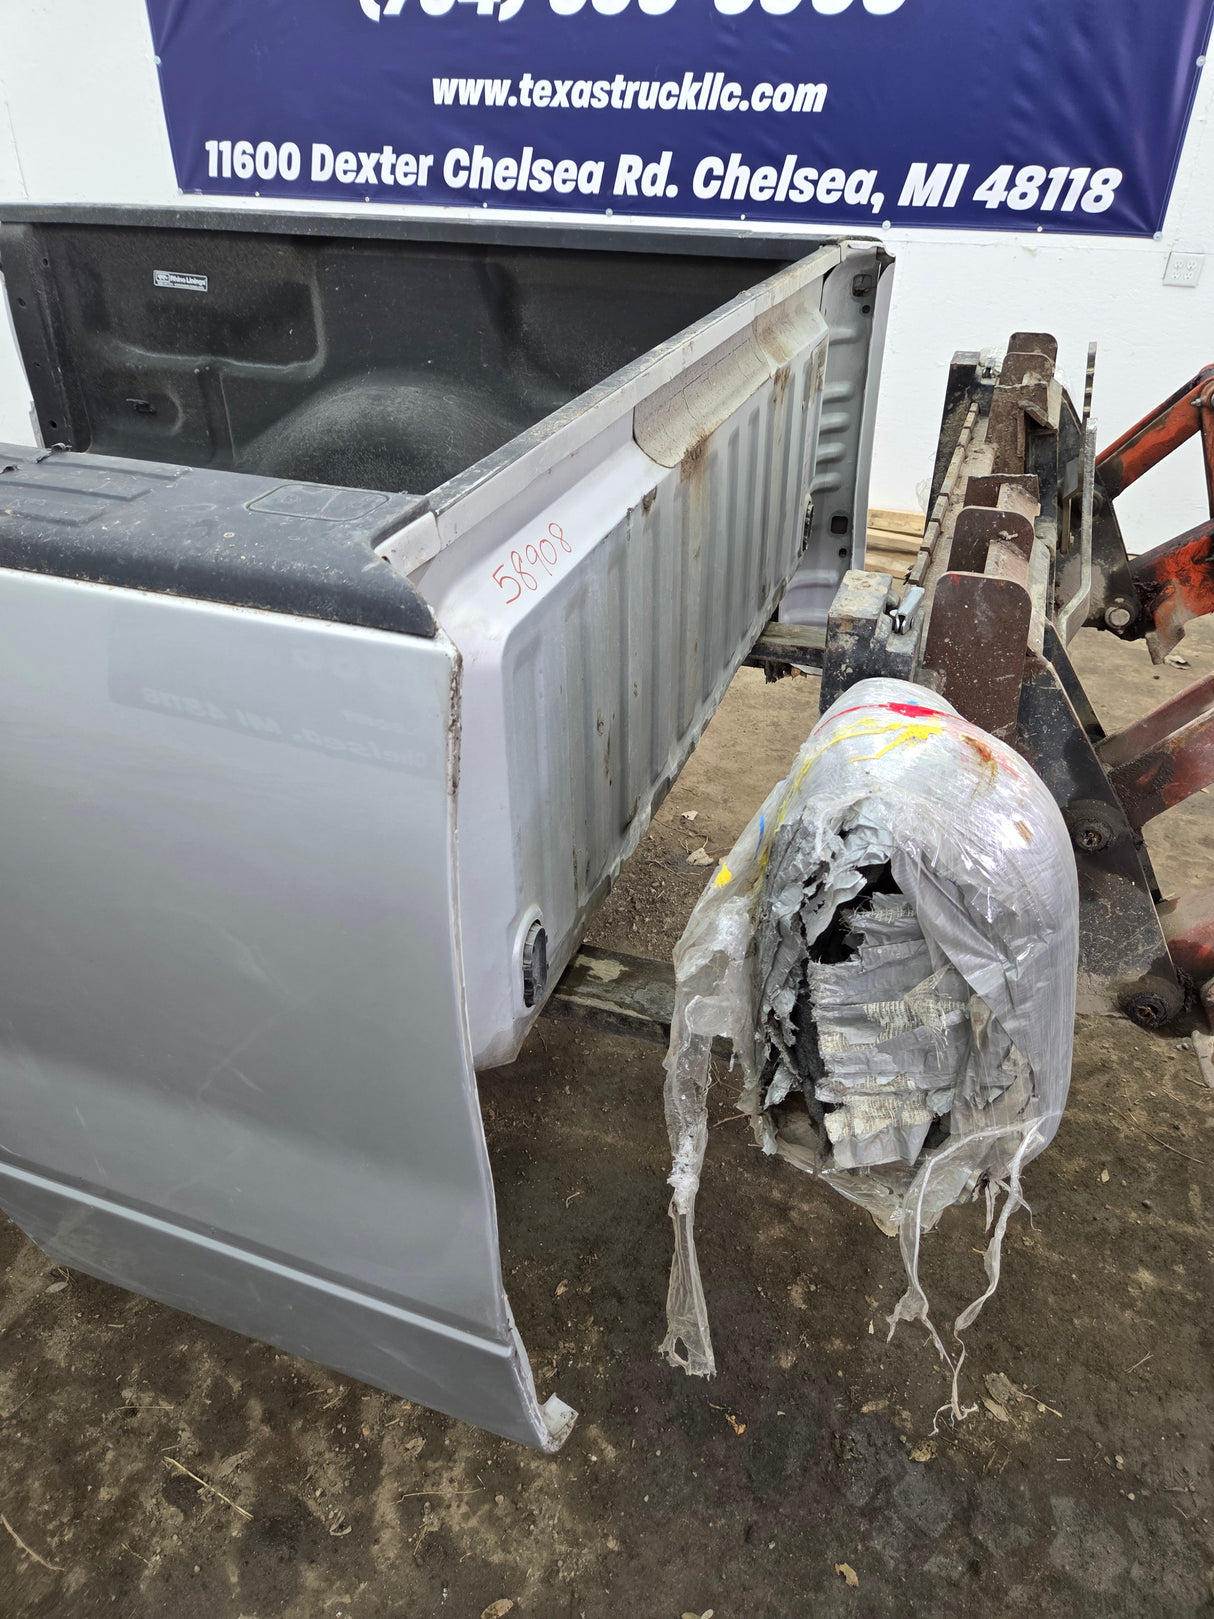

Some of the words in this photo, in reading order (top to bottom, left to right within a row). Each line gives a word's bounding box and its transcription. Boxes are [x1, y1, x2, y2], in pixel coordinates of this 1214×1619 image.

[432, 71, 828, 113] www.texastruckllc.com
[204, 140, 301, 181] 11600
[310, 143, 434, 187] Dexter
[443, 144, 605, 195] Chelsea
[612, 150, 679, 198] Rd.
[692, 152, 885, 214] Chelsea,
[897, 162, 971, 208] MI
[972, 164, 1123, 214] 48118
[492, 522, 572, 604] 58908
